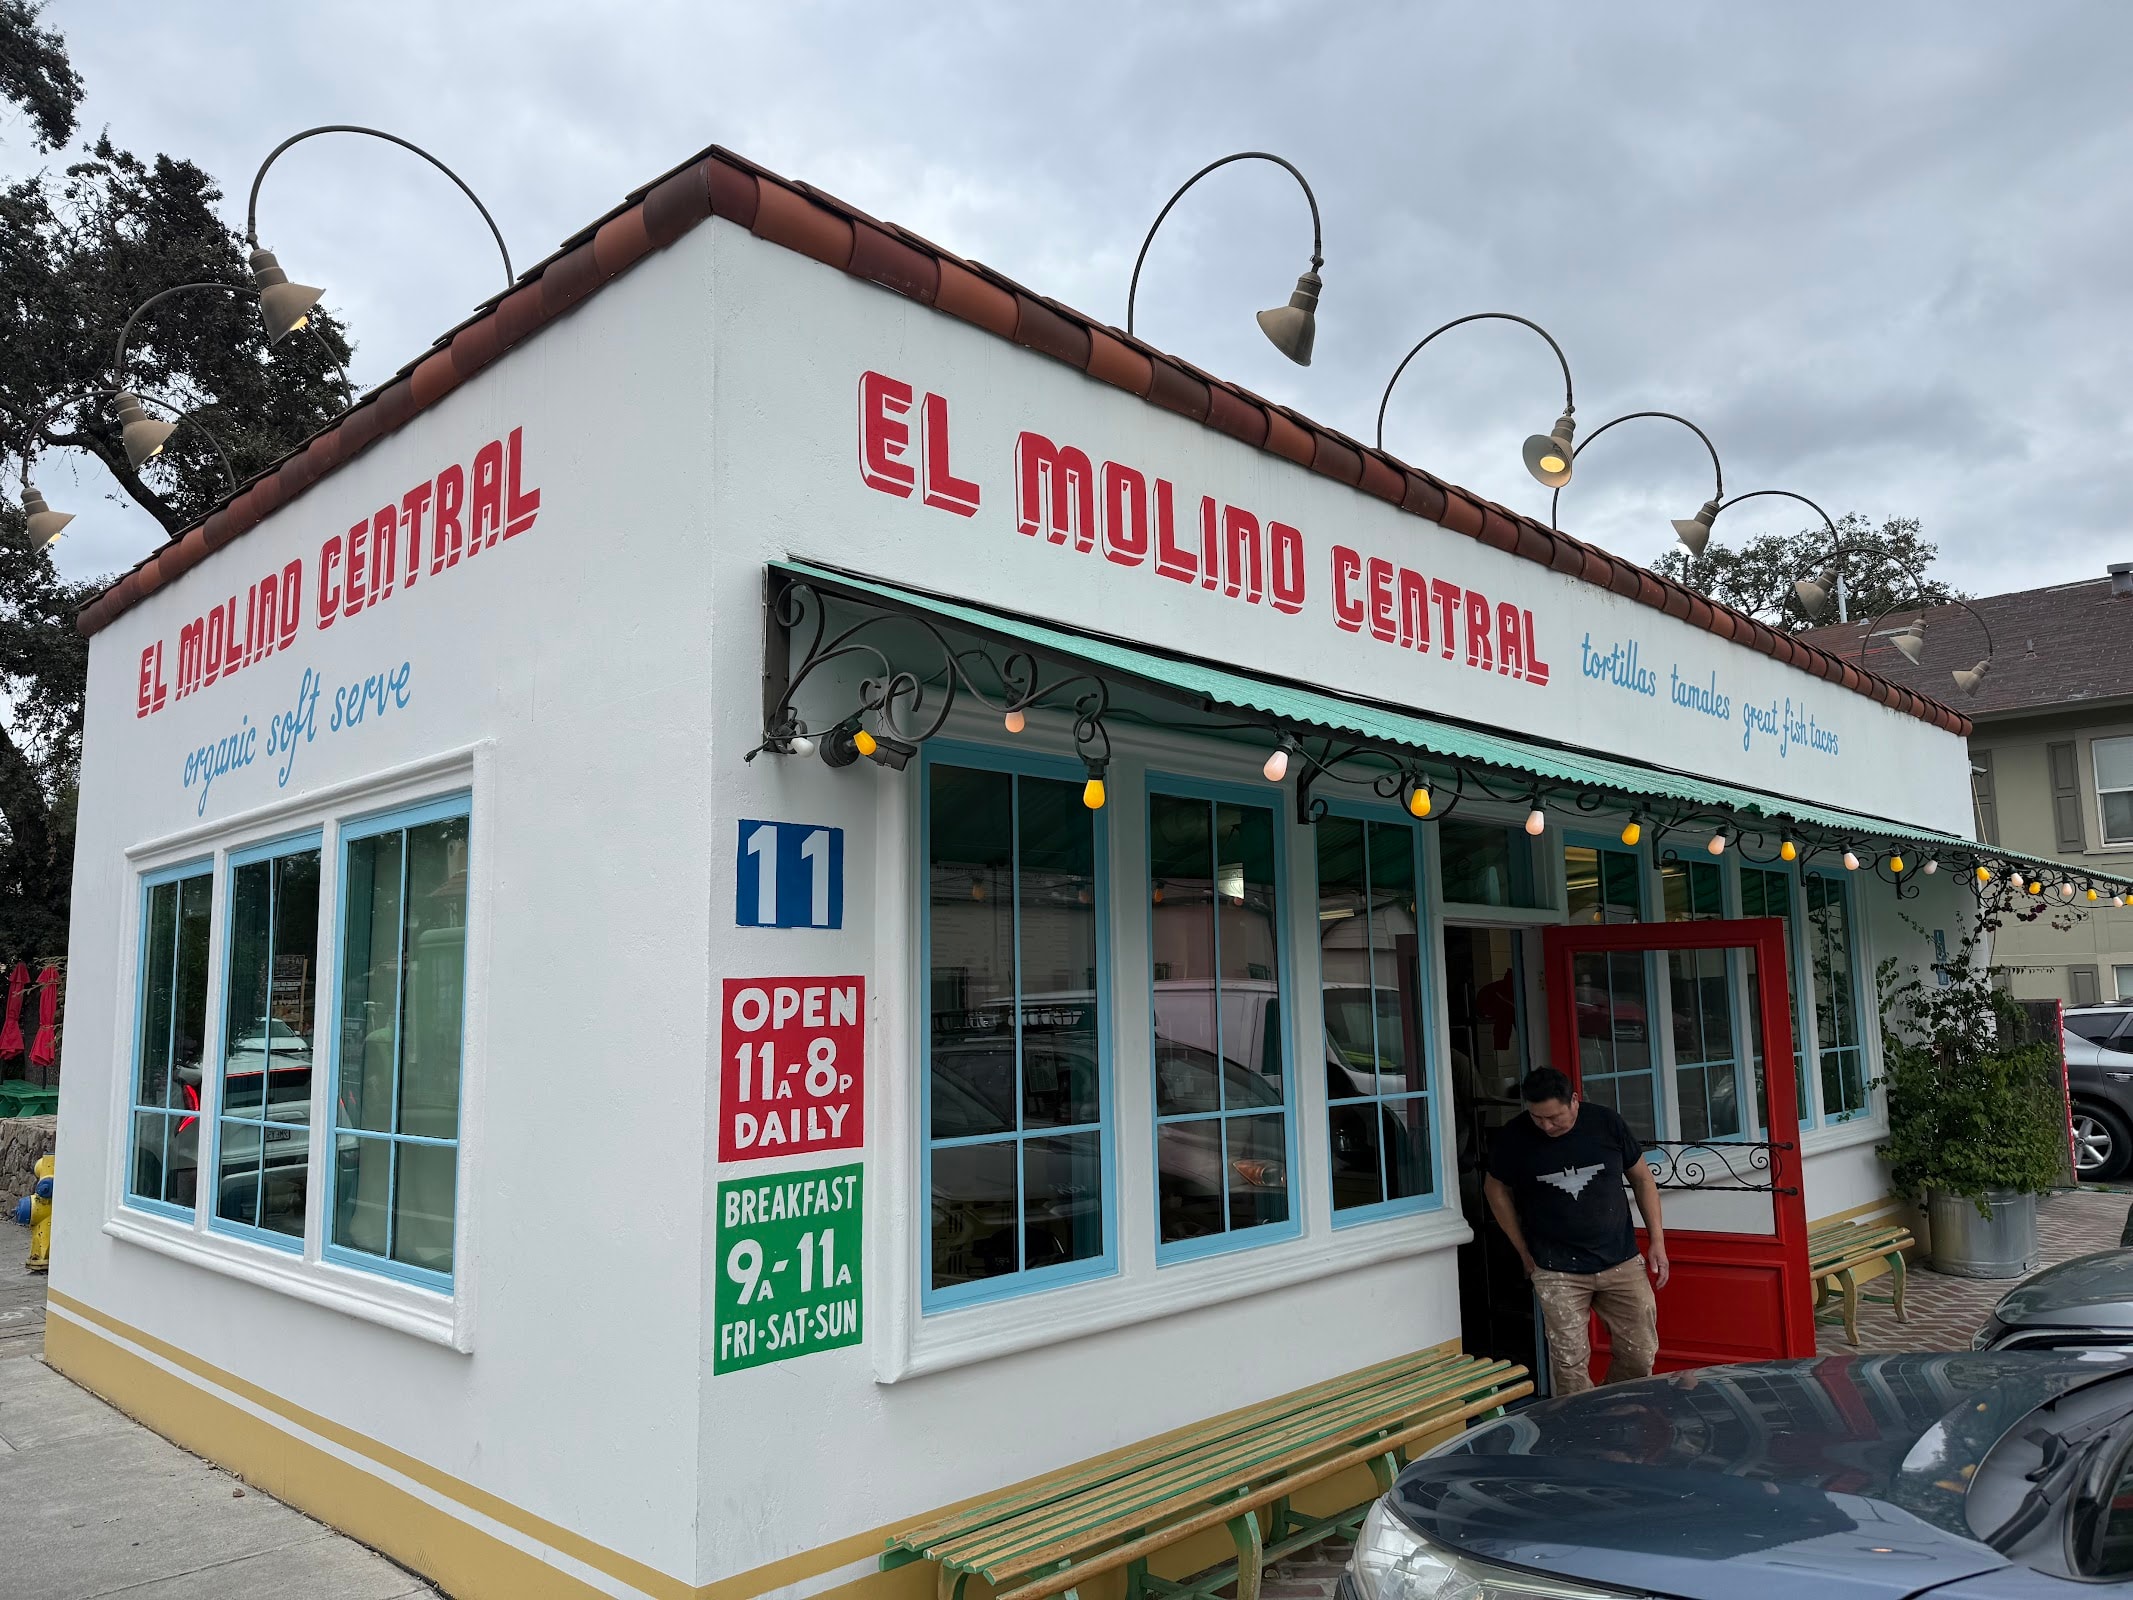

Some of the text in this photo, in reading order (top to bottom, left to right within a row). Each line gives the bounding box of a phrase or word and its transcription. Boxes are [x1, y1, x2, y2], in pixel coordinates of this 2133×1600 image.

[136, 427, 541, 721] EL MOLINO CENTRAL
[858, 370, 1550, 688] EL MOLINO CENTRAL
[182, 661, 412, 817] organic soft serve
[1580, 632, 1840, 758] tortillas tamales great fish tacos
[747, 825, 830, 926] 11
[732, 986, 857, 1032] OPEN
[735, 1103, 851, 1149] DAILY
[725, 1175, 857, 1228] BREAKFAST
